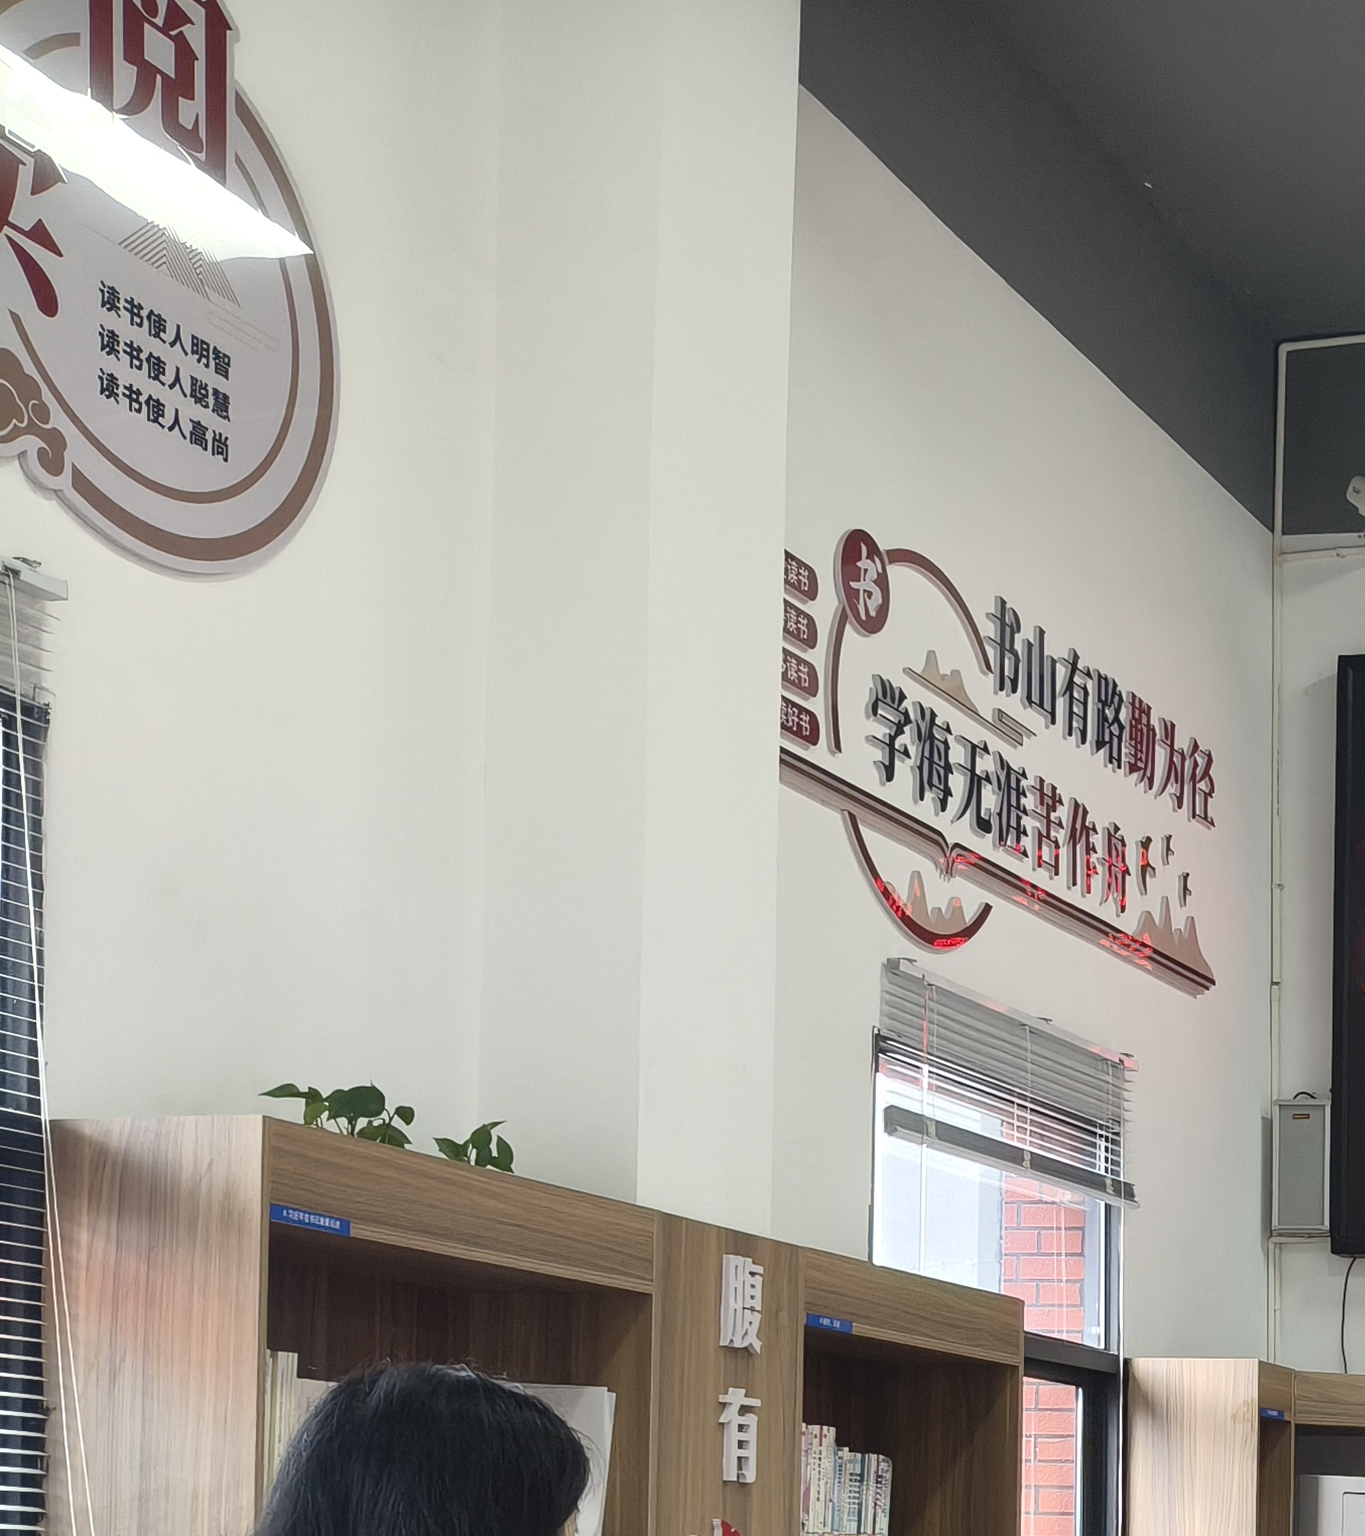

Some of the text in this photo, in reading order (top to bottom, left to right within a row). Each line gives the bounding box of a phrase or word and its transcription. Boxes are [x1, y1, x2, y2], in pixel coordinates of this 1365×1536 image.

[98, 280, 232, 382] 读书使人明智
[98, 324, 232, 423] 读书使人聪慧
[98, 367, 231, 464] 读书使人高尚
[984, 595, 1216, 829] 书山有路勤为径
[864, 673, 1132, 917] 学海无涯苦作舟
